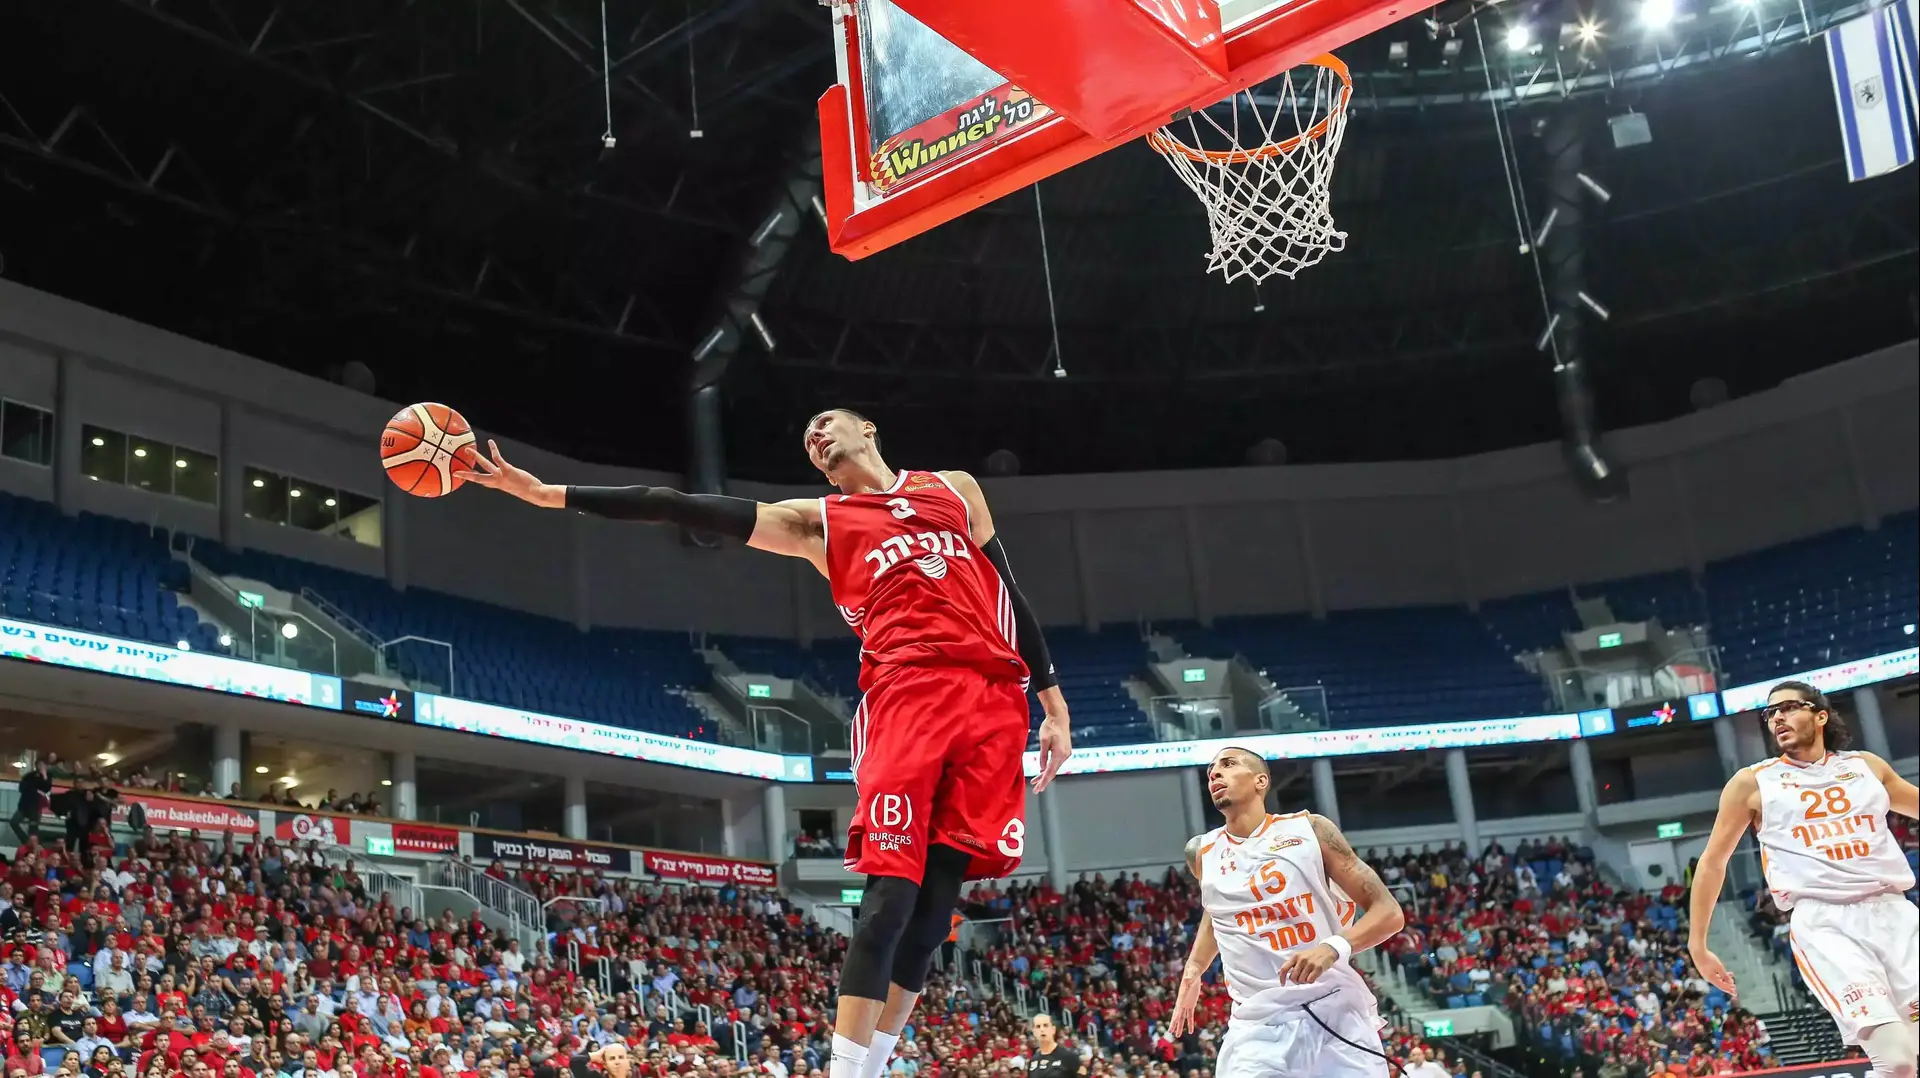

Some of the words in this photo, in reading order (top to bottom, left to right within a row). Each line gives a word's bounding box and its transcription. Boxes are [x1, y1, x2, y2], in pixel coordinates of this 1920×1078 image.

[959, 97, 996, 129] ליגת
[1003, 101, 1031, 125] סל
[889, 114, 1001, 177] Winner
[886, 497, 917, 520] 3
[44, 632, 110, 652] עושים
[1800, 786, 1851, 820] 28
[168, 806, 229, 825] basketball
[229, 815, 255, 828] club
[395, 837, 455, 851] BASKETBALL
[869, 832, 912, 845] BURGERS
[997, 817, 1025, 857] 3
[1791, 814, 1876, 848] דיזנגוף
[880, 841, 900, 852] BAR
[1816, 839, 1871, 861] סחר
[1243, 860, 1287, 903] 15
[1234, 892, 1315, 936] דיזנגוף
[1259, 921, 1317, 951] סחר
